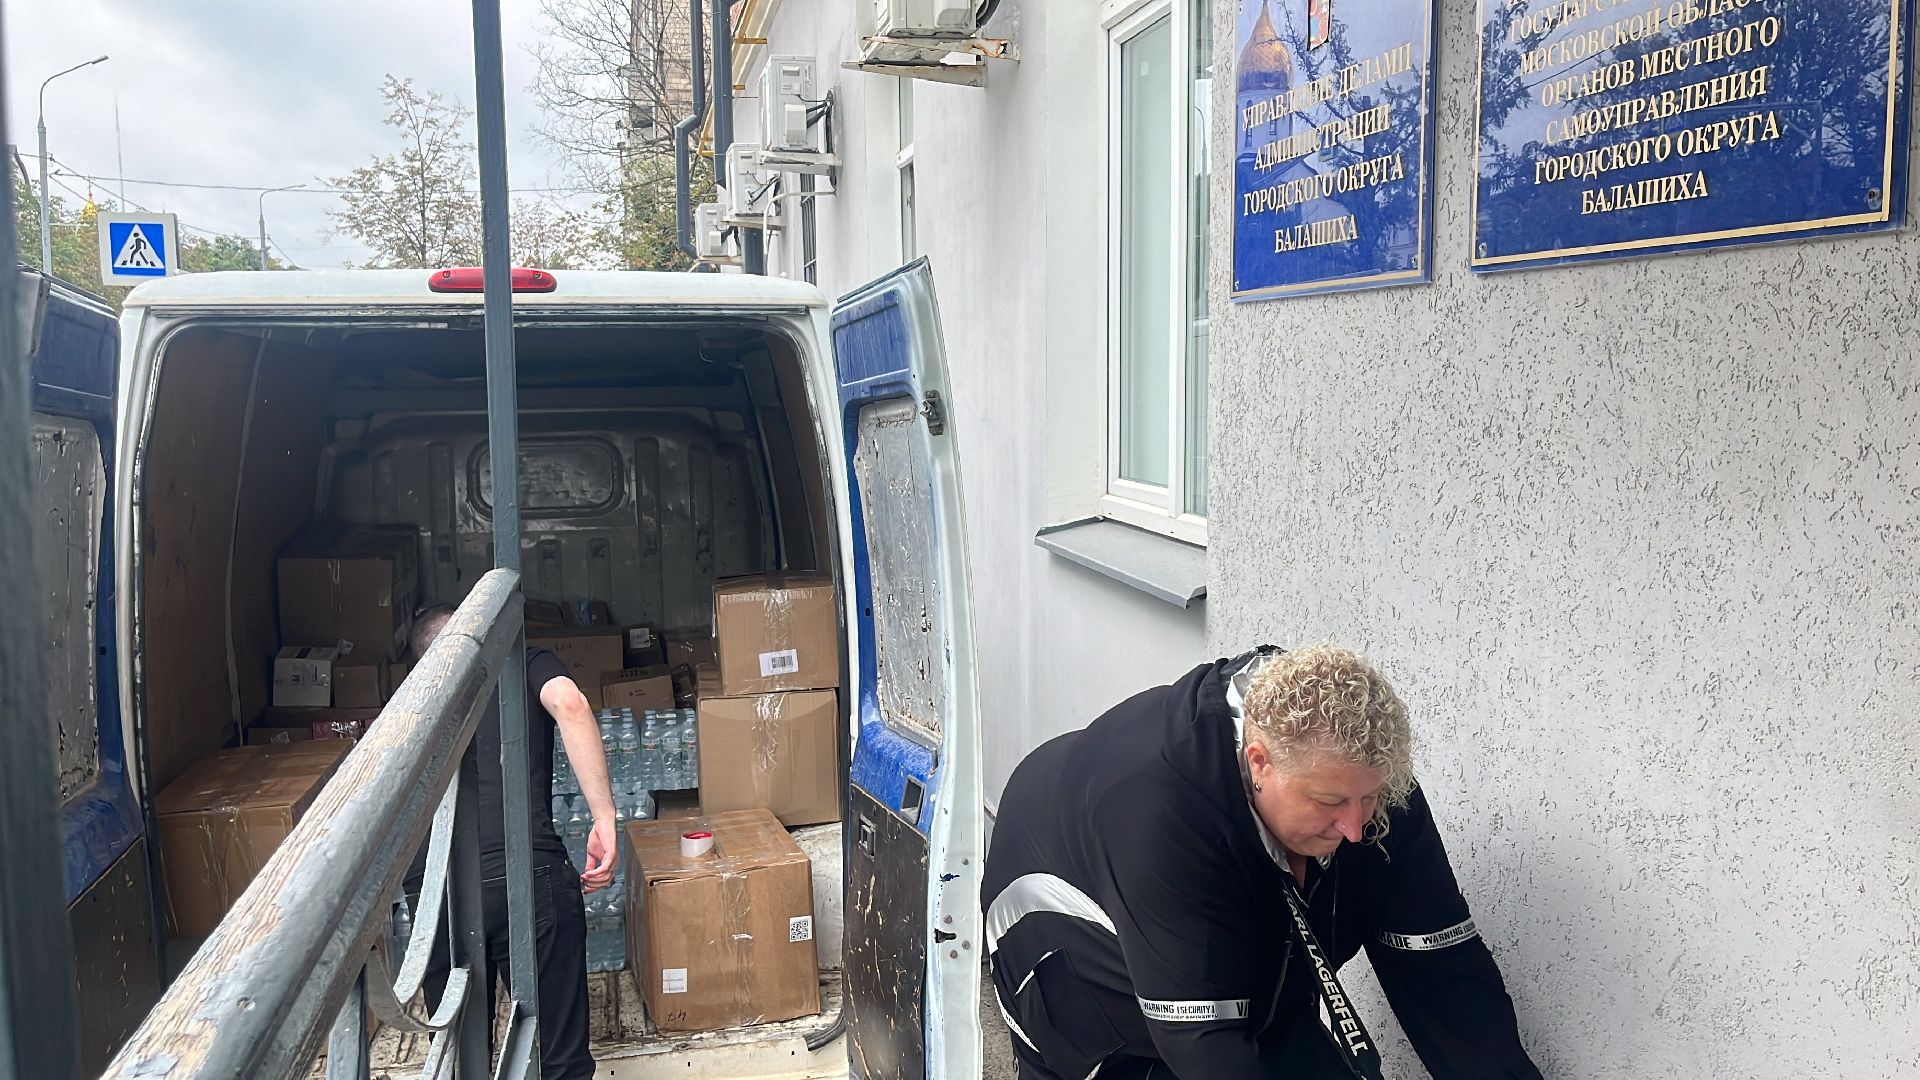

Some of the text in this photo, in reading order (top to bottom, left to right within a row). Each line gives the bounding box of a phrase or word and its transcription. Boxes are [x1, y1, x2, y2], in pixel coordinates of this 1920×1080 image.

[1511, 0, 1629, 42] ГОСУДАР
[1520, 2, 1661, 75] МОСКОВСКОЙ
[1338, 42, 1412, 101] ДЕЛАМИ
[1541, 16, 1779, 106] ОРГАНОВ МЕСТНОГО
[1546, 66, 1768, 145] САМОУПРАВЛЕНИЯ
[1254, 104, 1391, 174] АДМИНИСТРАЦИИ
[1534, 111, 1780, 185] ГОРОДСКОГО ОКРУГА
[1243, 153, 1404, 216] ГОРОДСКОГО ОКРУГА
[1581, 171, 1709, 215] БАЛАШИХА
[1275, 213, 1359, 254] БАЛАШИХА
[1422, 926, 1464, 945] WARNING
[1143, 1002, 1175, 1014] WARNING
